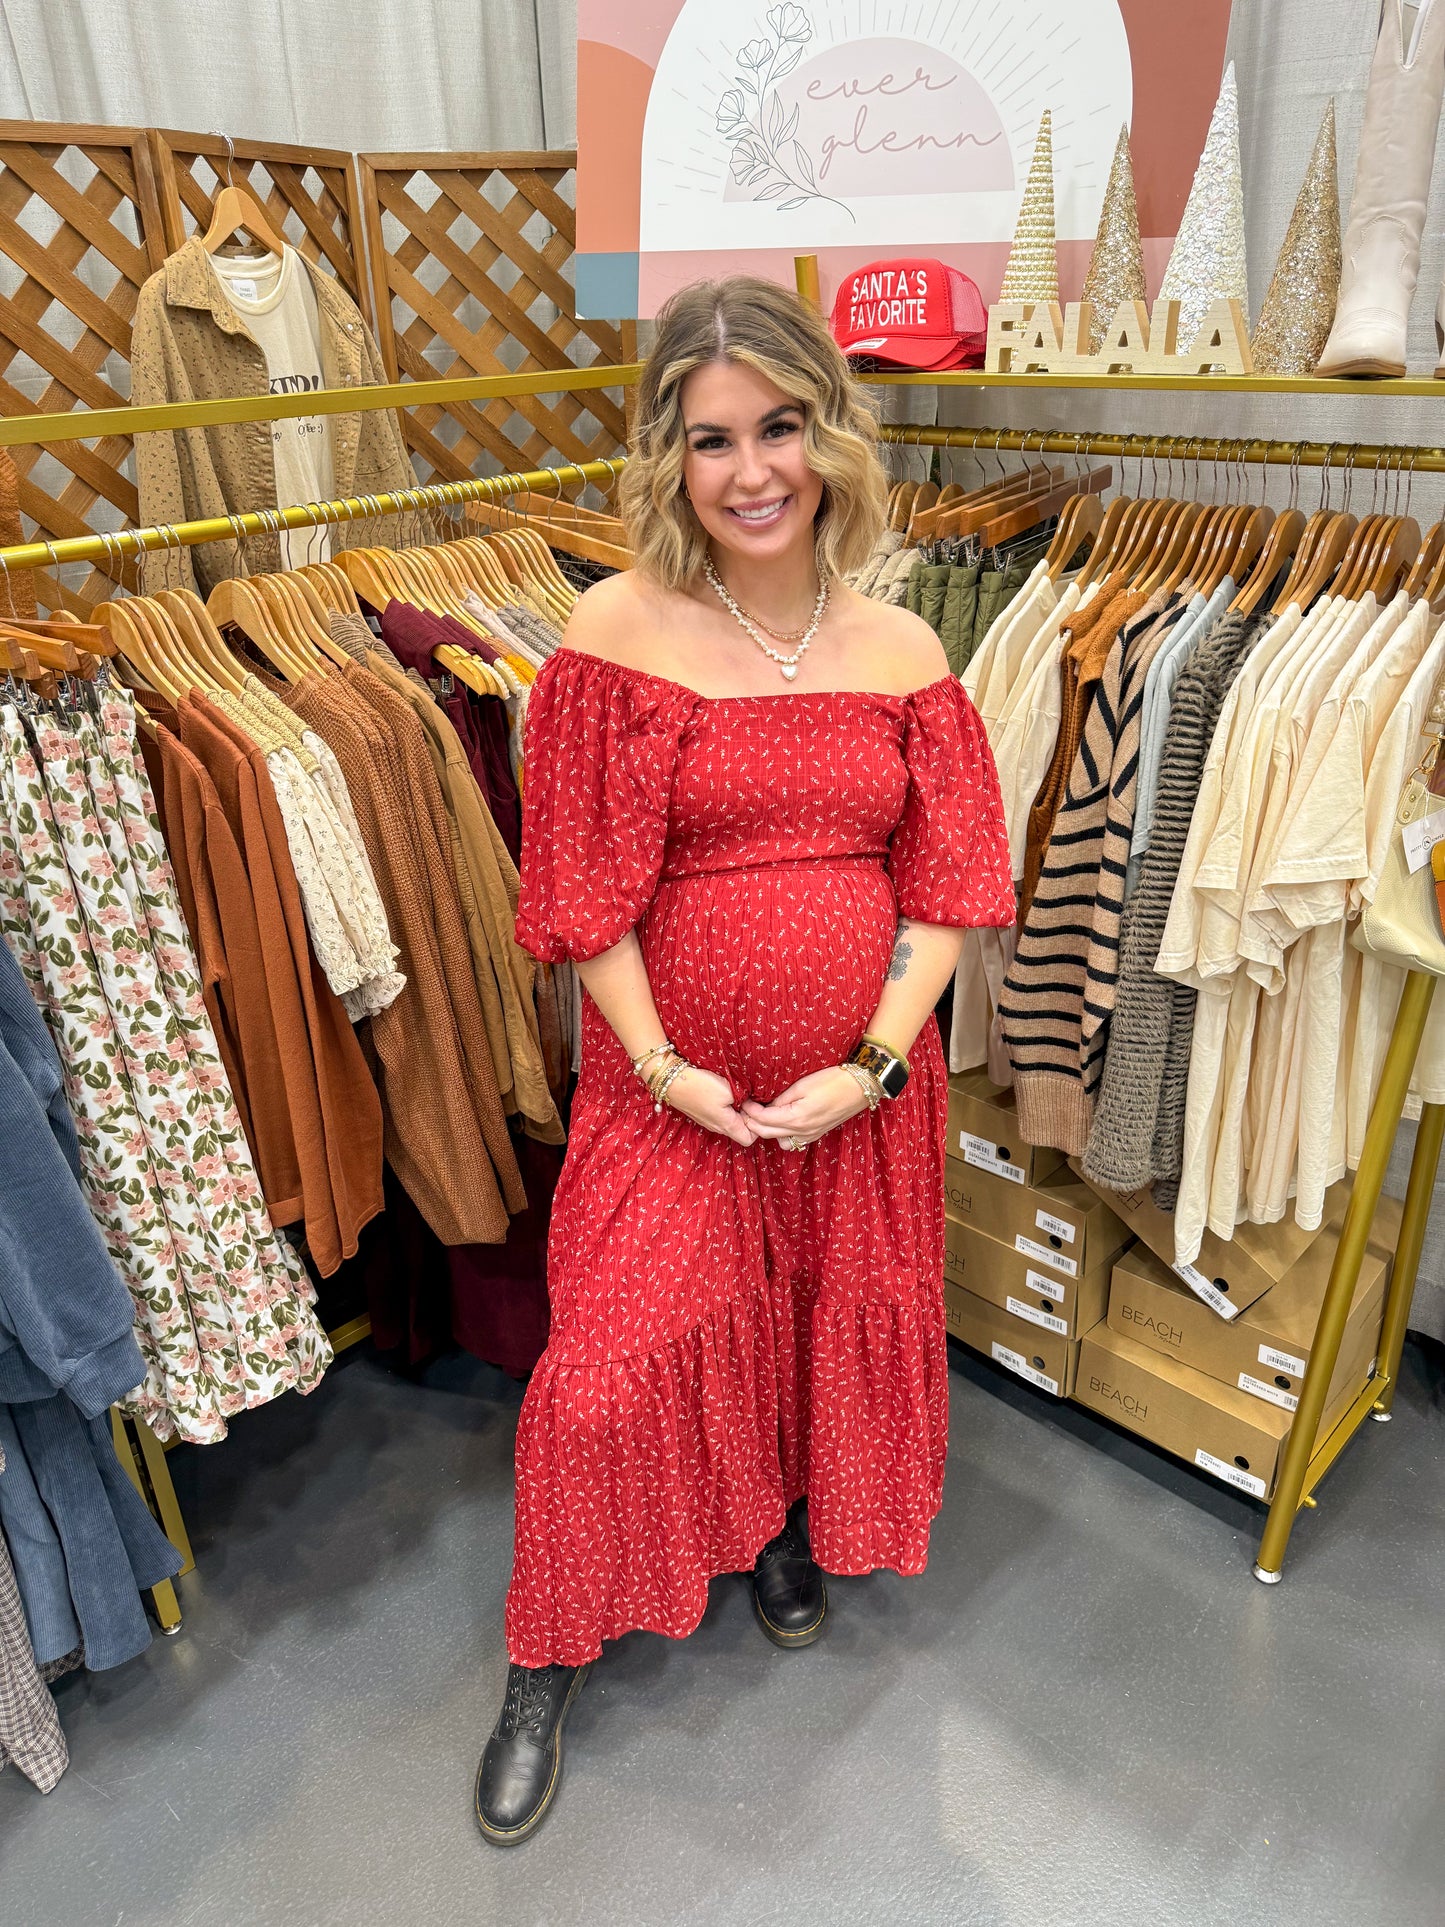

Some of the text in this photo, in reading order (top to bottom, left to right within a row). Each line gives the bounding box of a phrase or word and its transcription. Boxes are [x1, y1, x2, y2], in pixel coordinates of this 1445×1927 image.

[806, 67, 958, 100] ever
[819, 104, 1002, 180] glenn
[851, 270, 927, 303] SANTA'S
[849, 298, 927, 332] FAVORITE
[944, 1184, 972, 1210] ACH
[1121, 1304, 1183, 1344] BEACH
[1089, 1376, 1148, 1418] BEACH
